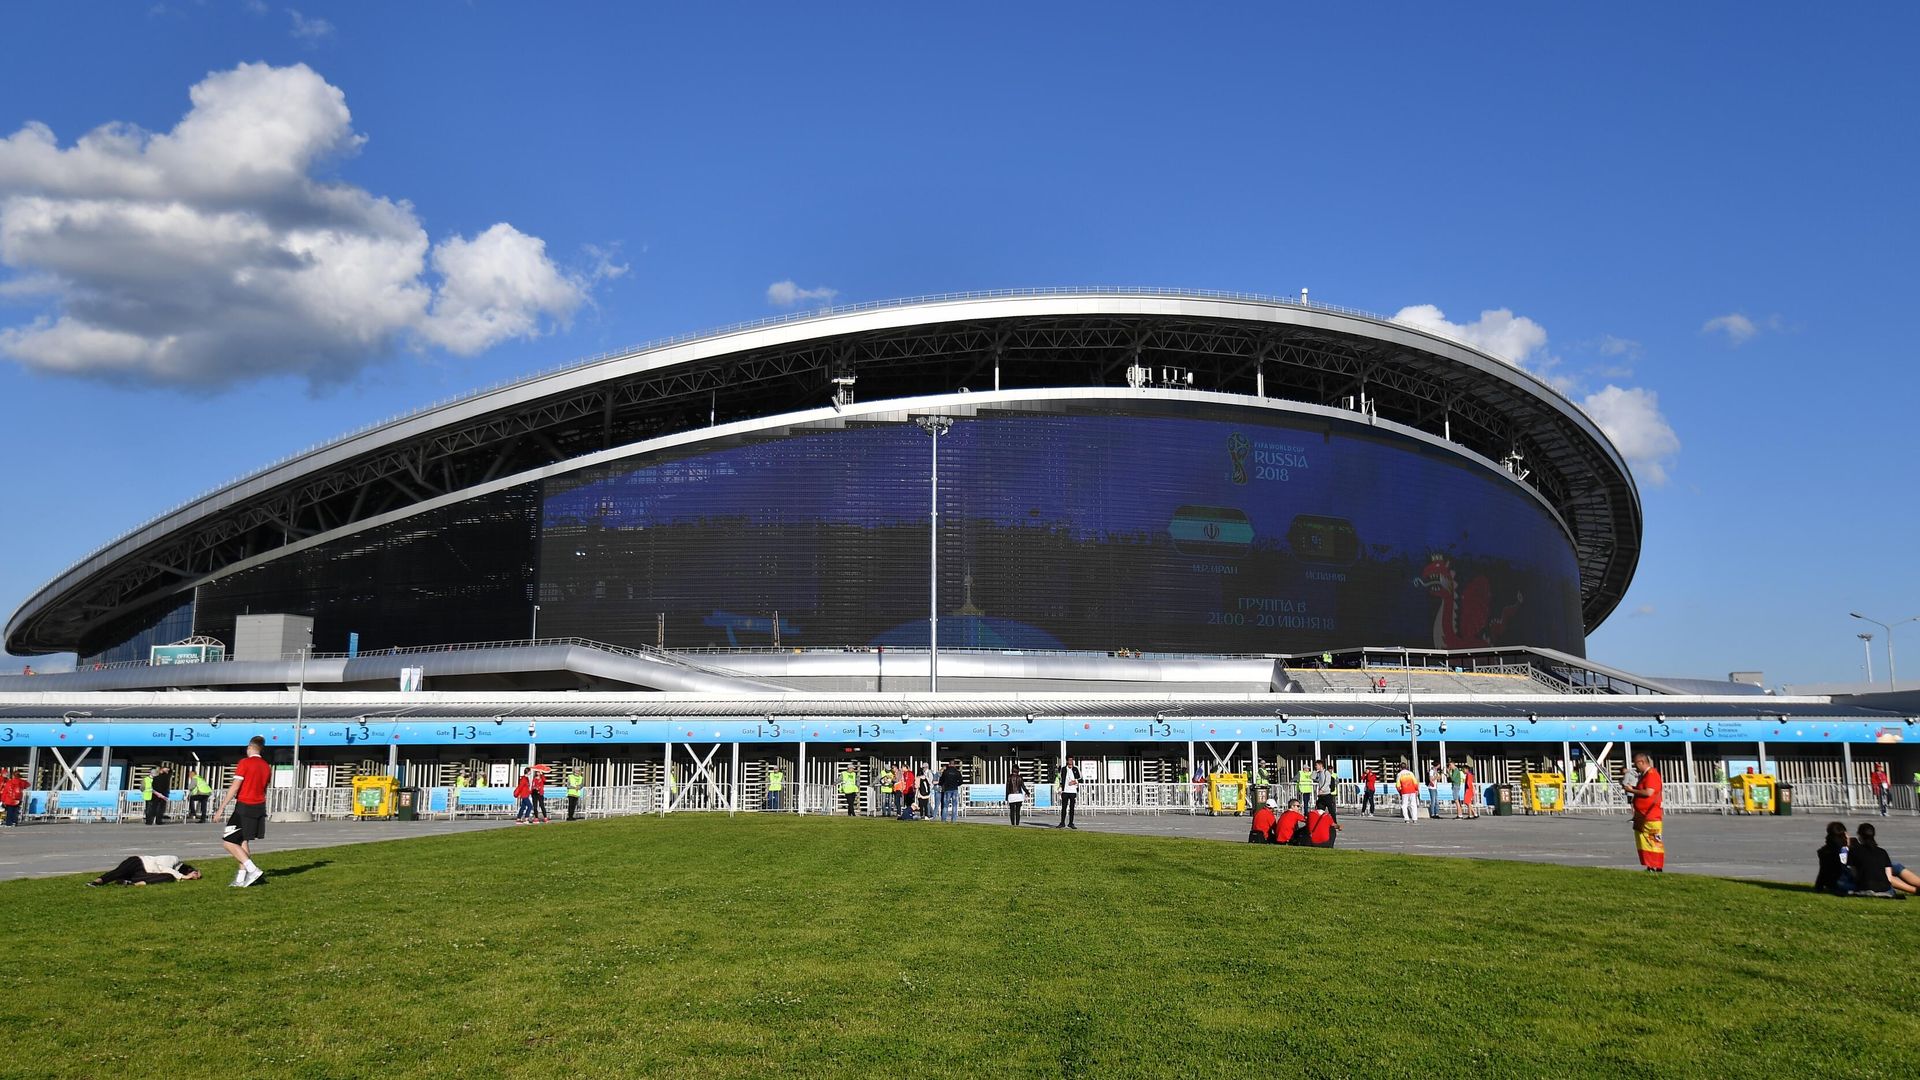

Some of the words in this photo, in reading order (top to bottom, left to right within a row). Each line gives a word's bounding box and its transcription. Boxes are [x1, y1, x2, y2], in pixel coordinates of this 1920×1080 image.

[1254, 441, 1268, 449] FIFA
[1269, 443, 1292, 451] WORLD
[1254, 450, 1308, 469] RUSSIA
[1255, 466, 1289, 482] 2018
[1238, 598, 1294, 613] ГРУППА
[1256, 614, 1276, 628] 20
[1278, 615, 1320, 630] ИЮНЯ
[1322, 618, 1336, 631] 18
[169, 728, 194, 742] 1-3
[345, 727, 370, 740] 1-3
[452, 726, 476, 740] 1-3
[590, 725, 614, 739] 1-3
[758, 724, 781, 738] 1-3
[858, 724, 881, 738] 1-3
[986, 724, 1010, 737] 1-3
[1148, 724, 1172, 737] 1-3
[1275, 724, 1298, 737] 1-3
[1494, 724, 1516, 738] 1-3
[1648, 724, 1670, 738] 1-3
